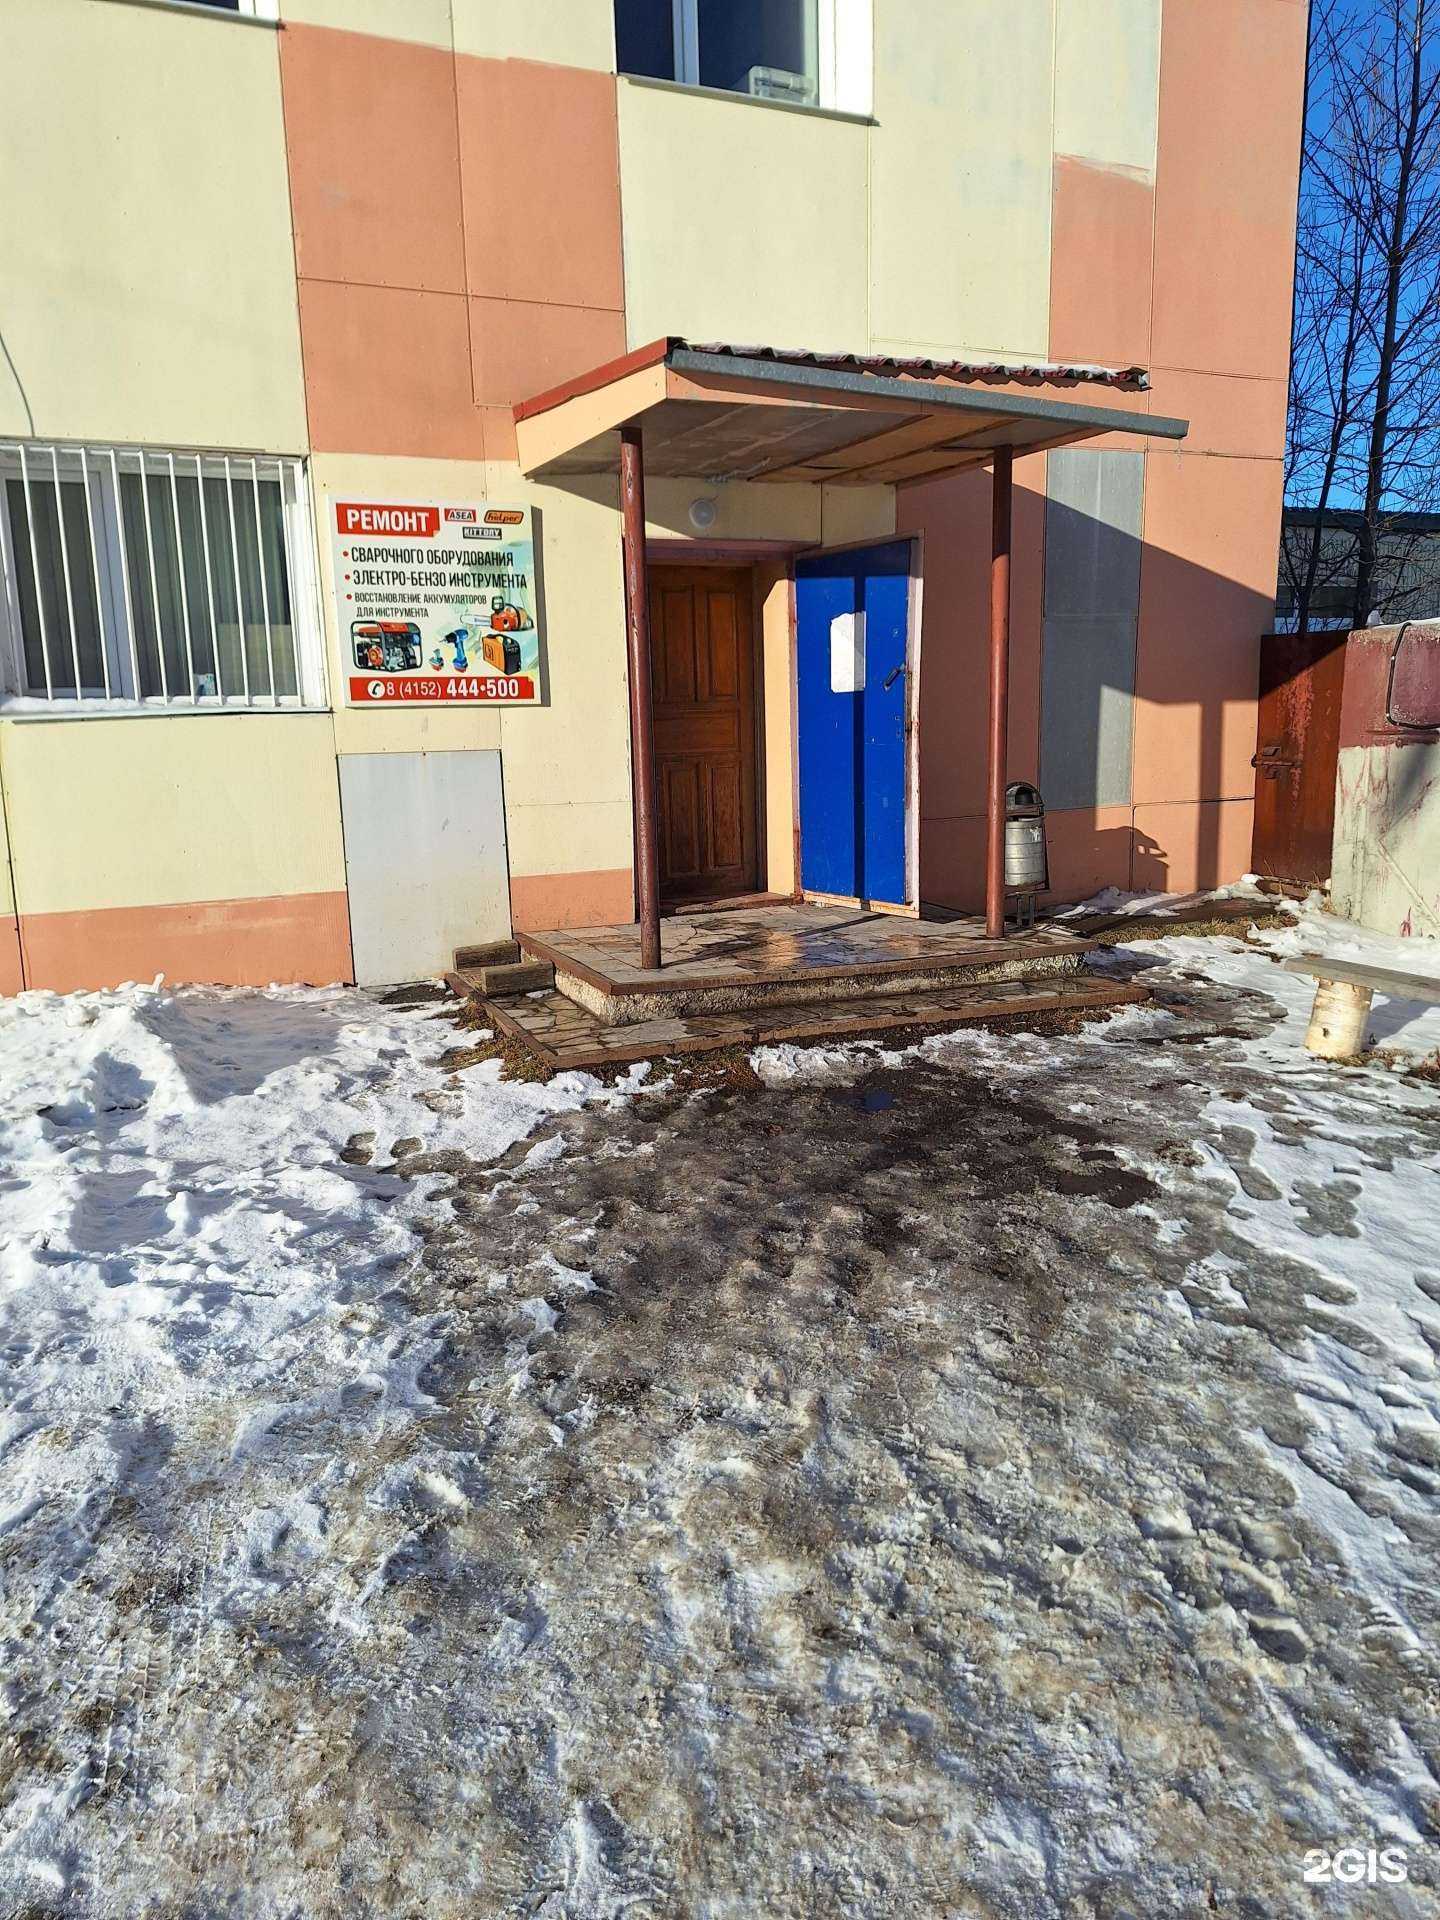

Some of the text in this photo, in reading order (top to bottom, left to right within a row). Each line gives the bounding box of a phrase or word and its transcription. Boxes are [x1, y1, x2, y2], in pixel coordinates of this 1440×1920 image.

[346, 508, 430, 532] РЕМОНТ
[449, 511, 473, 520] ASEA
[351, 547, 513, 566] СВАРОЧНОГО ОБОРУДОВАНИЯ
[353, 570, 527, 588] ЭЛЕКТРО-БЕНЗО ИНСТРУМЕНТА
[354, 592, 487, 605] ВОССТАНОВЛЕНИЕ АККУМУЛЯТОРОВ
[356, 606, 429, 618] ДЛЯ ИНСТРУМЕНТА
[386, 680, 395, 696] 8
[399, 681, 442, 697] (4152)
